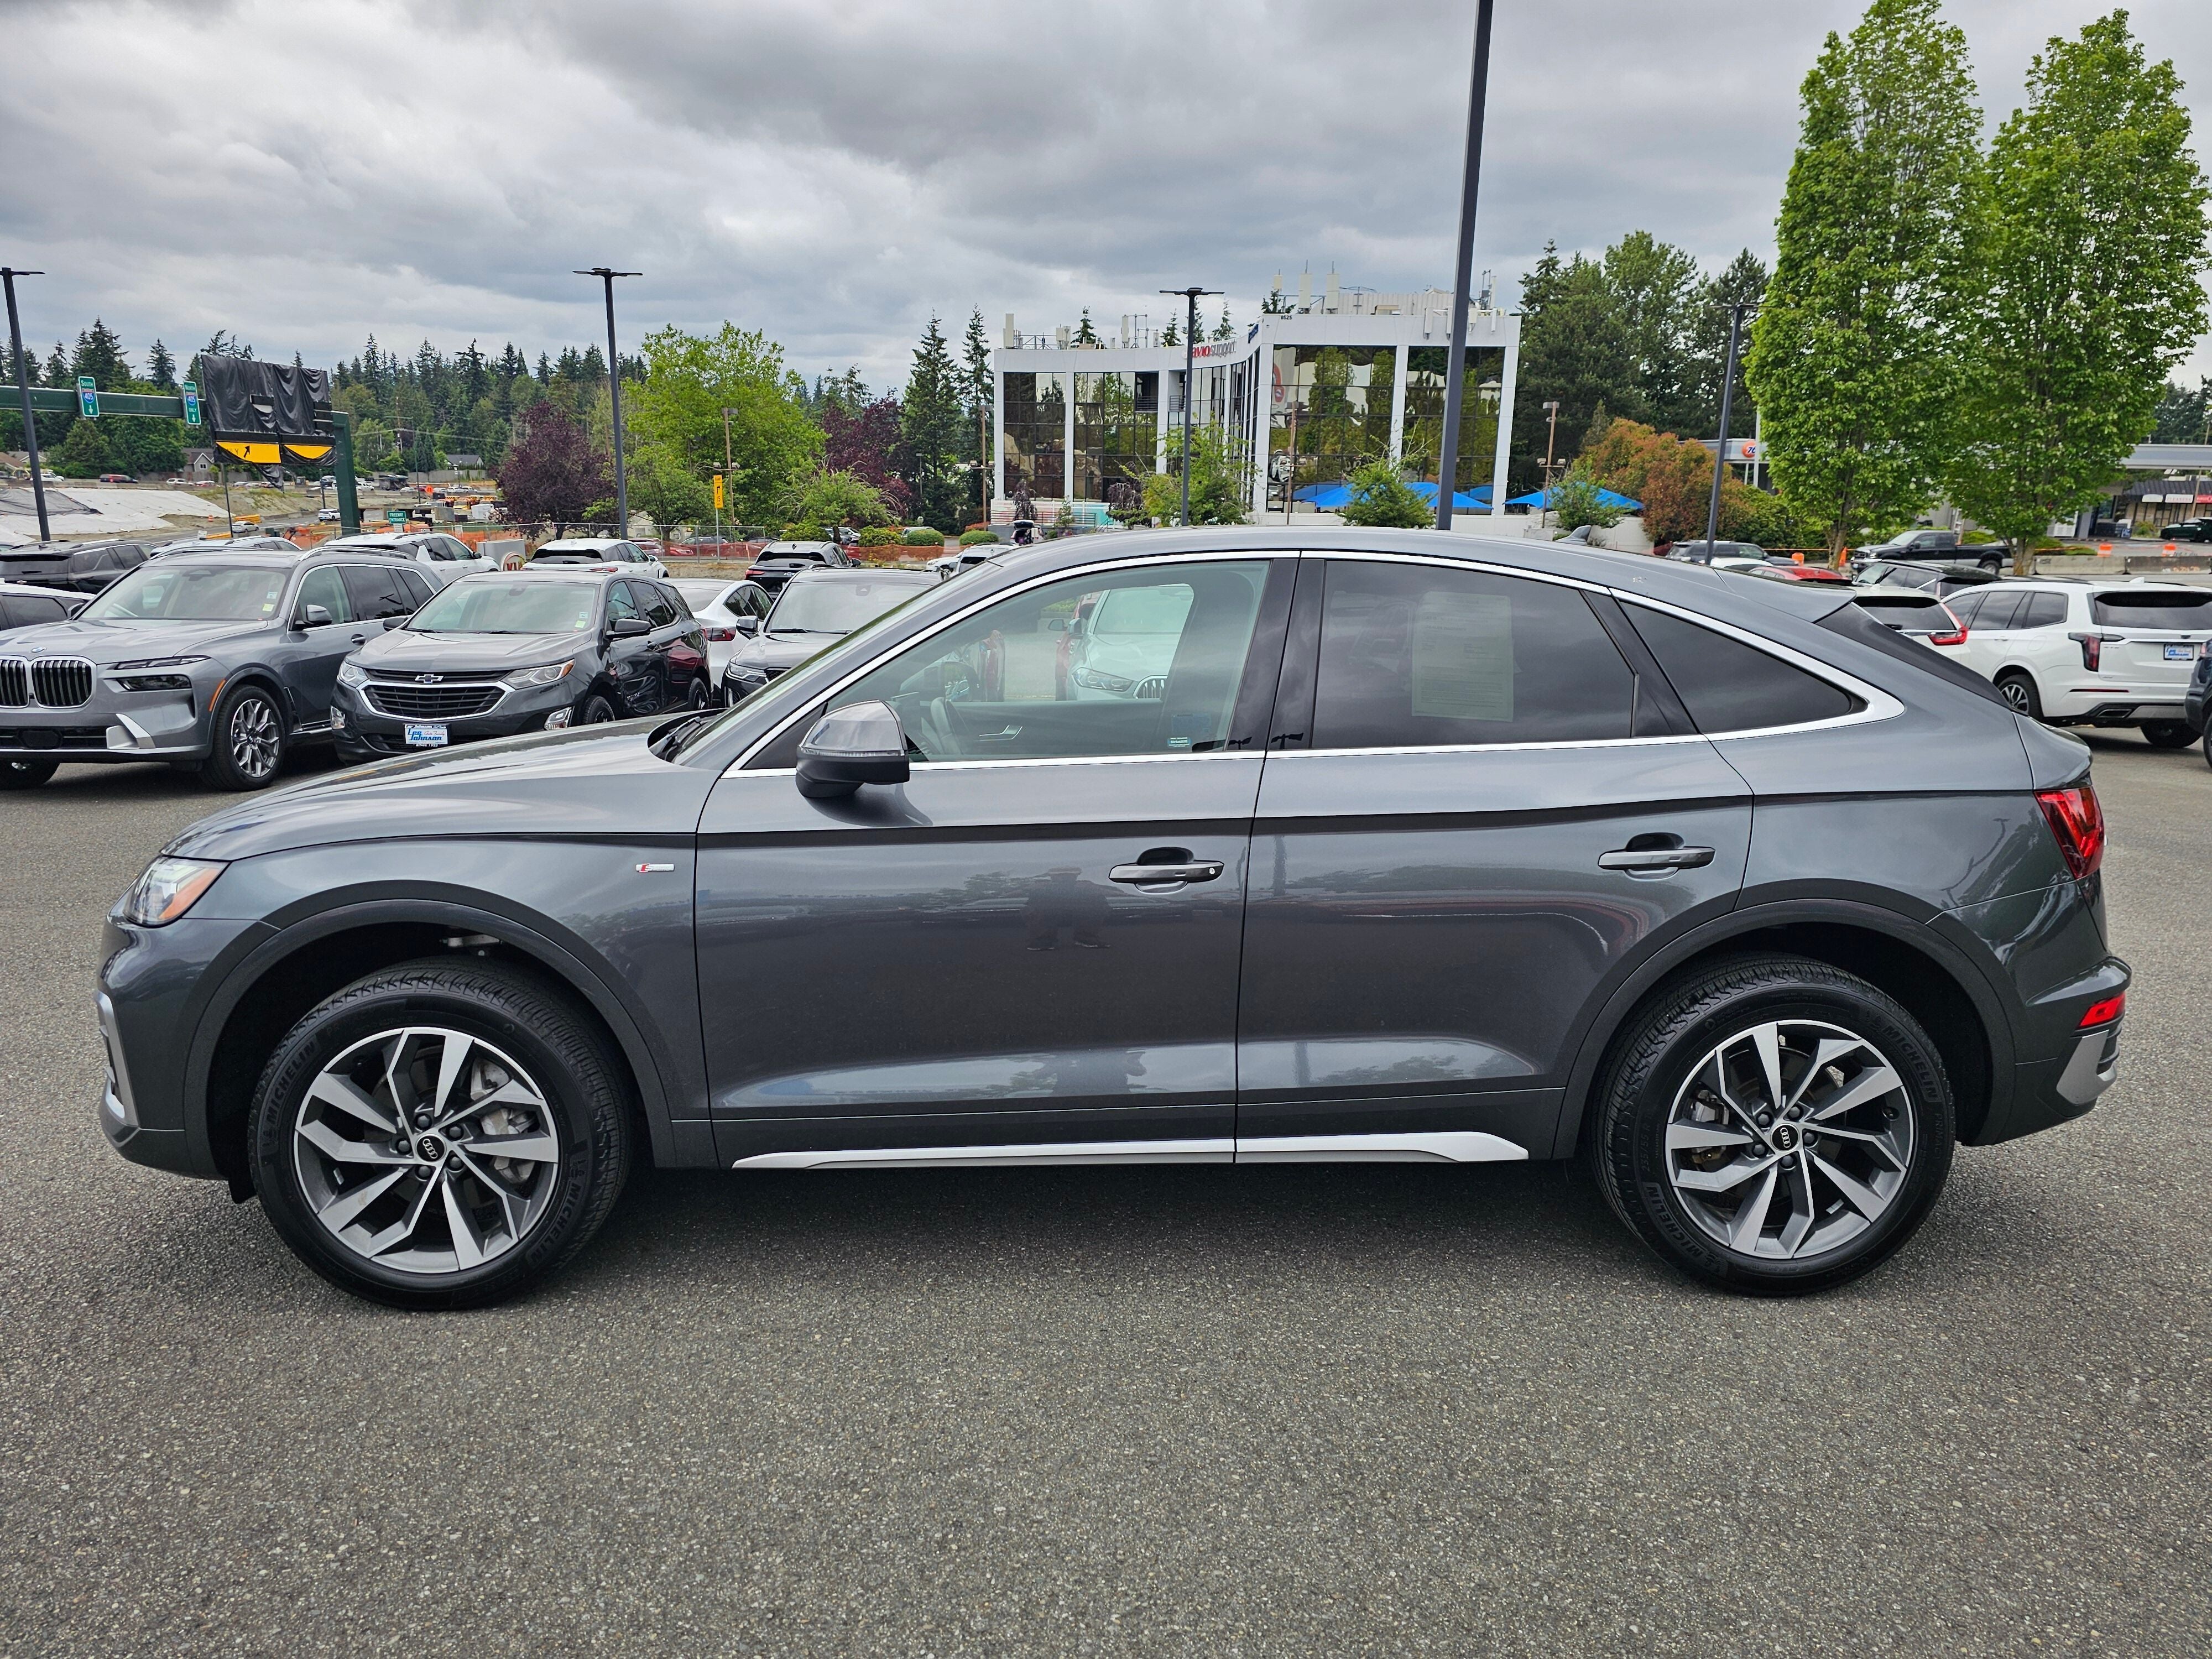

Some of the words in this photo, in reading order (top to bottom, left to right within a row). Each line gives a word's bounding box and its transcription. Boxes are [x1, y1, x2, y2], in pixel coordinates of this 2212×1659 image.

[267, 1042, 317, 1122] MICHELIN
[1881, 1025, 1938, 1102] MICHELIN
[527, 1182, 581, 1265] MICHELIN
[1646, 1186, 1709, 1265] MICHELIN
